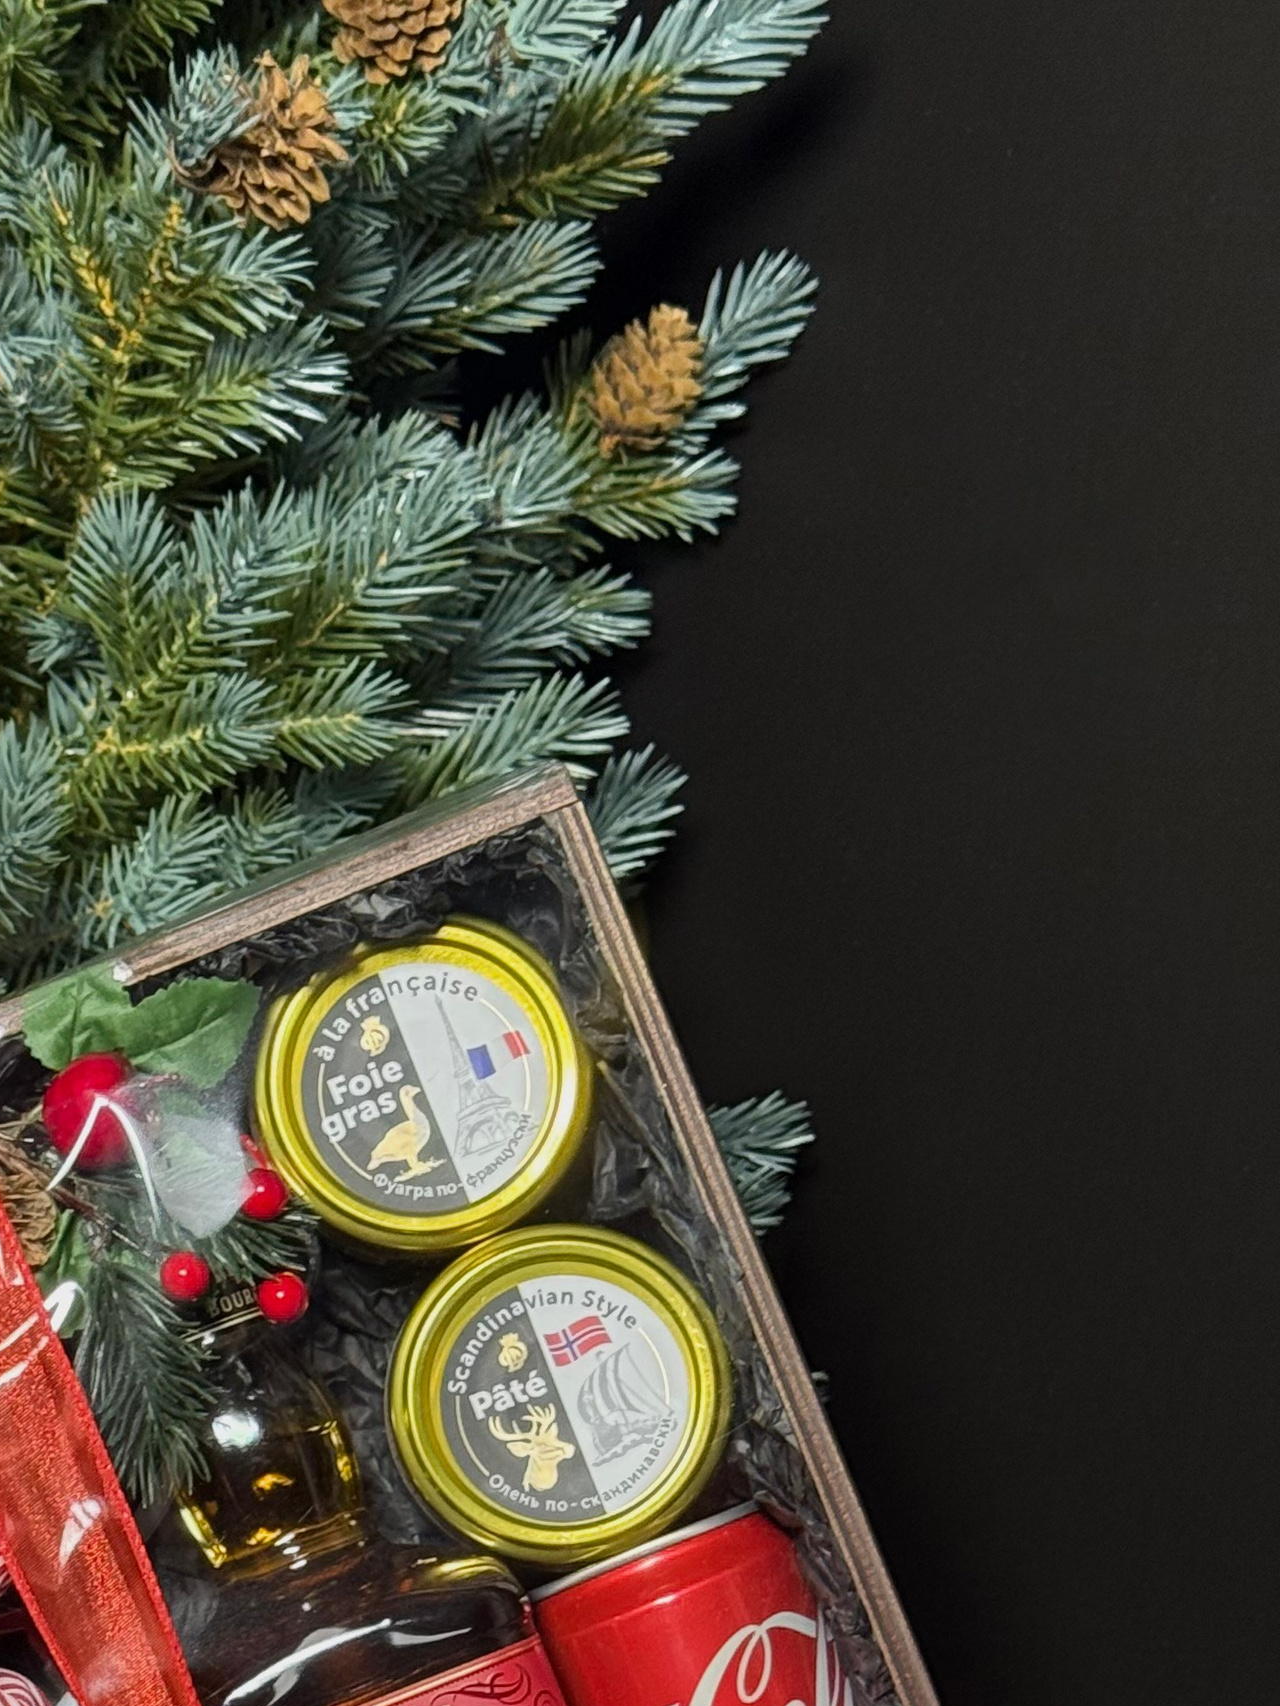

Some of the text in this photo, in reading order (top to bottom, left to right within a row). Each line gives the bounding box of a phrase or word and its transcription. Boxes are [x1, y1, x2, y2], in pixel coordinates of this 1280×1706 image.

[312, 971, 479, 1062] à la française
[326, 1060, 404, 1106] Foie
[321, 1090, 398, 1143] gras
[373, 1172, 434, 1201] Фуагра
[447, 1288, 639, 1395] Scandinavian Style
[468, 1370, 549, 1421] Pâté
[488, 1473, 540, 1511] Олень
